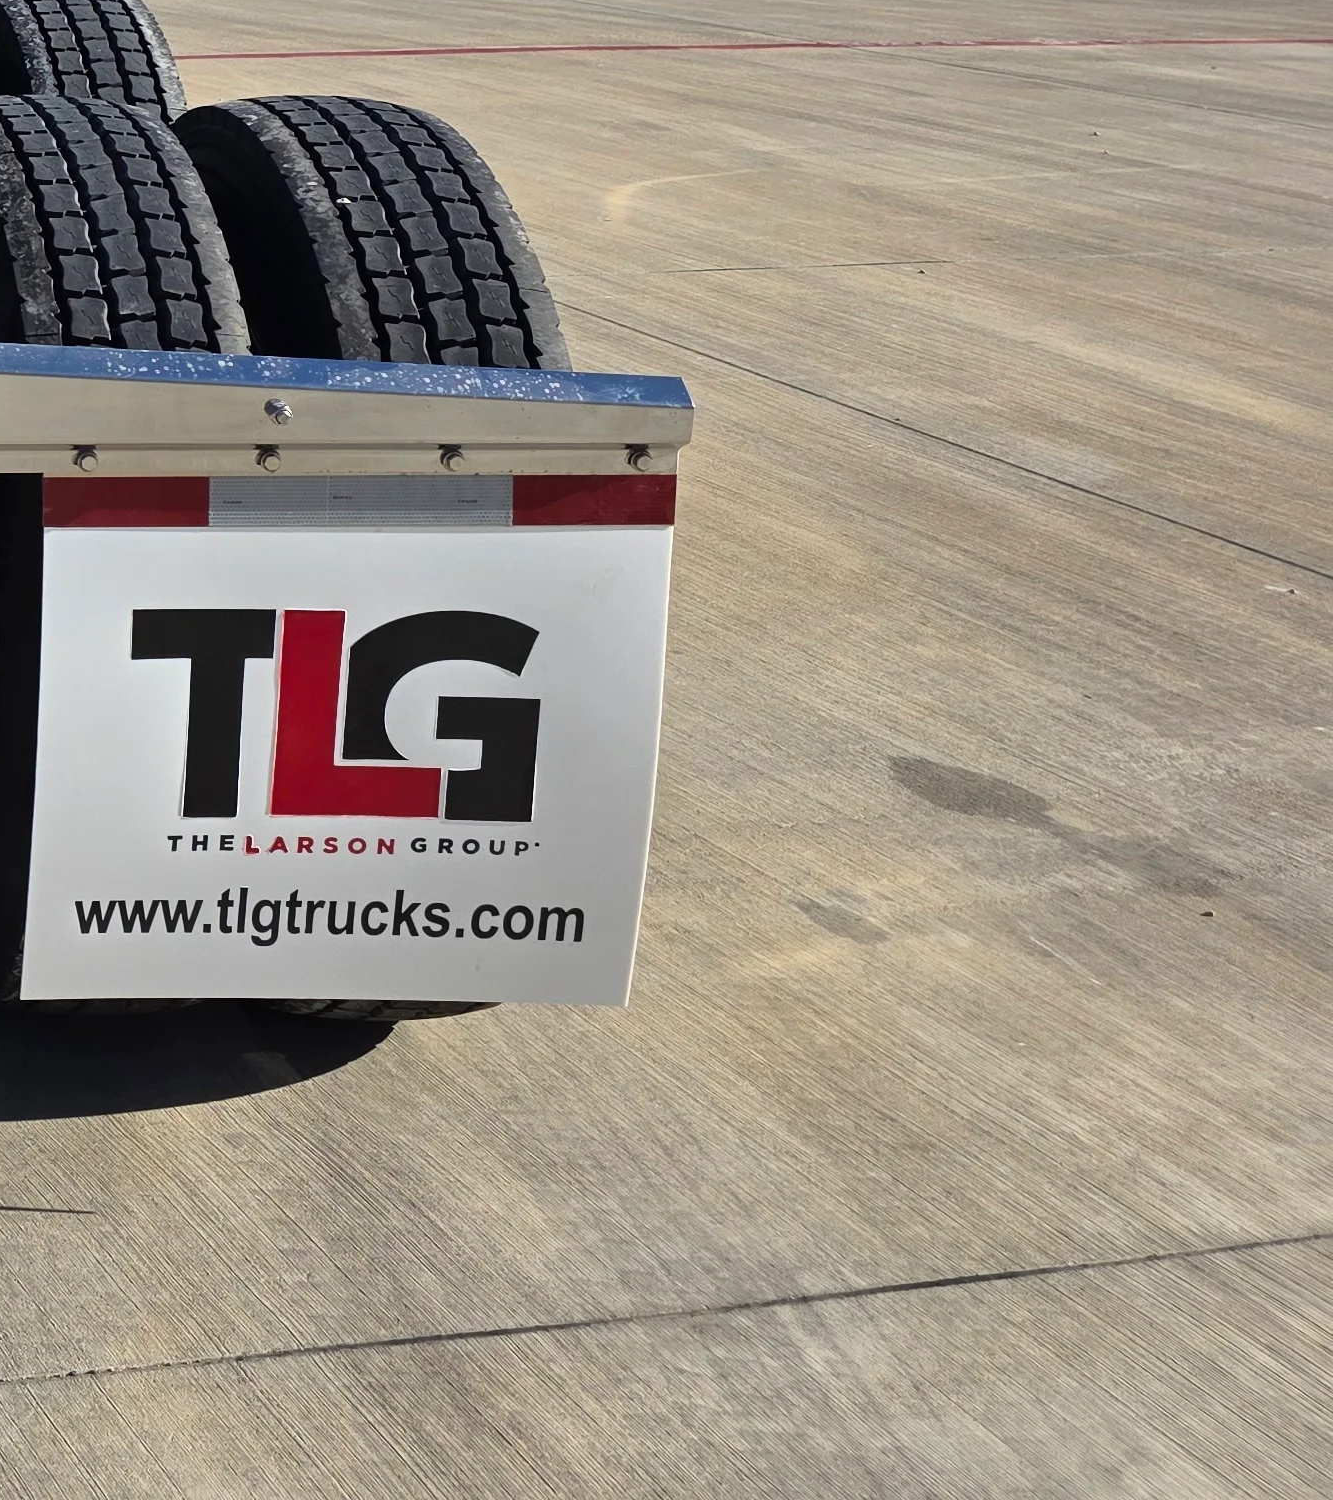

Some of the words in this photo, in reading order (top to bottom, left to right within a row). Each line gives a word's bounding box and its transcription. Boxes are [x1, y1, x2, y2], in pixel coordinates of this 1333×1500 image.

[130, 608, 541, 822] TLG
[410, 837, 530, 857] GROUP
[74, 887, 585, 947] www.tlgtrucks.com
